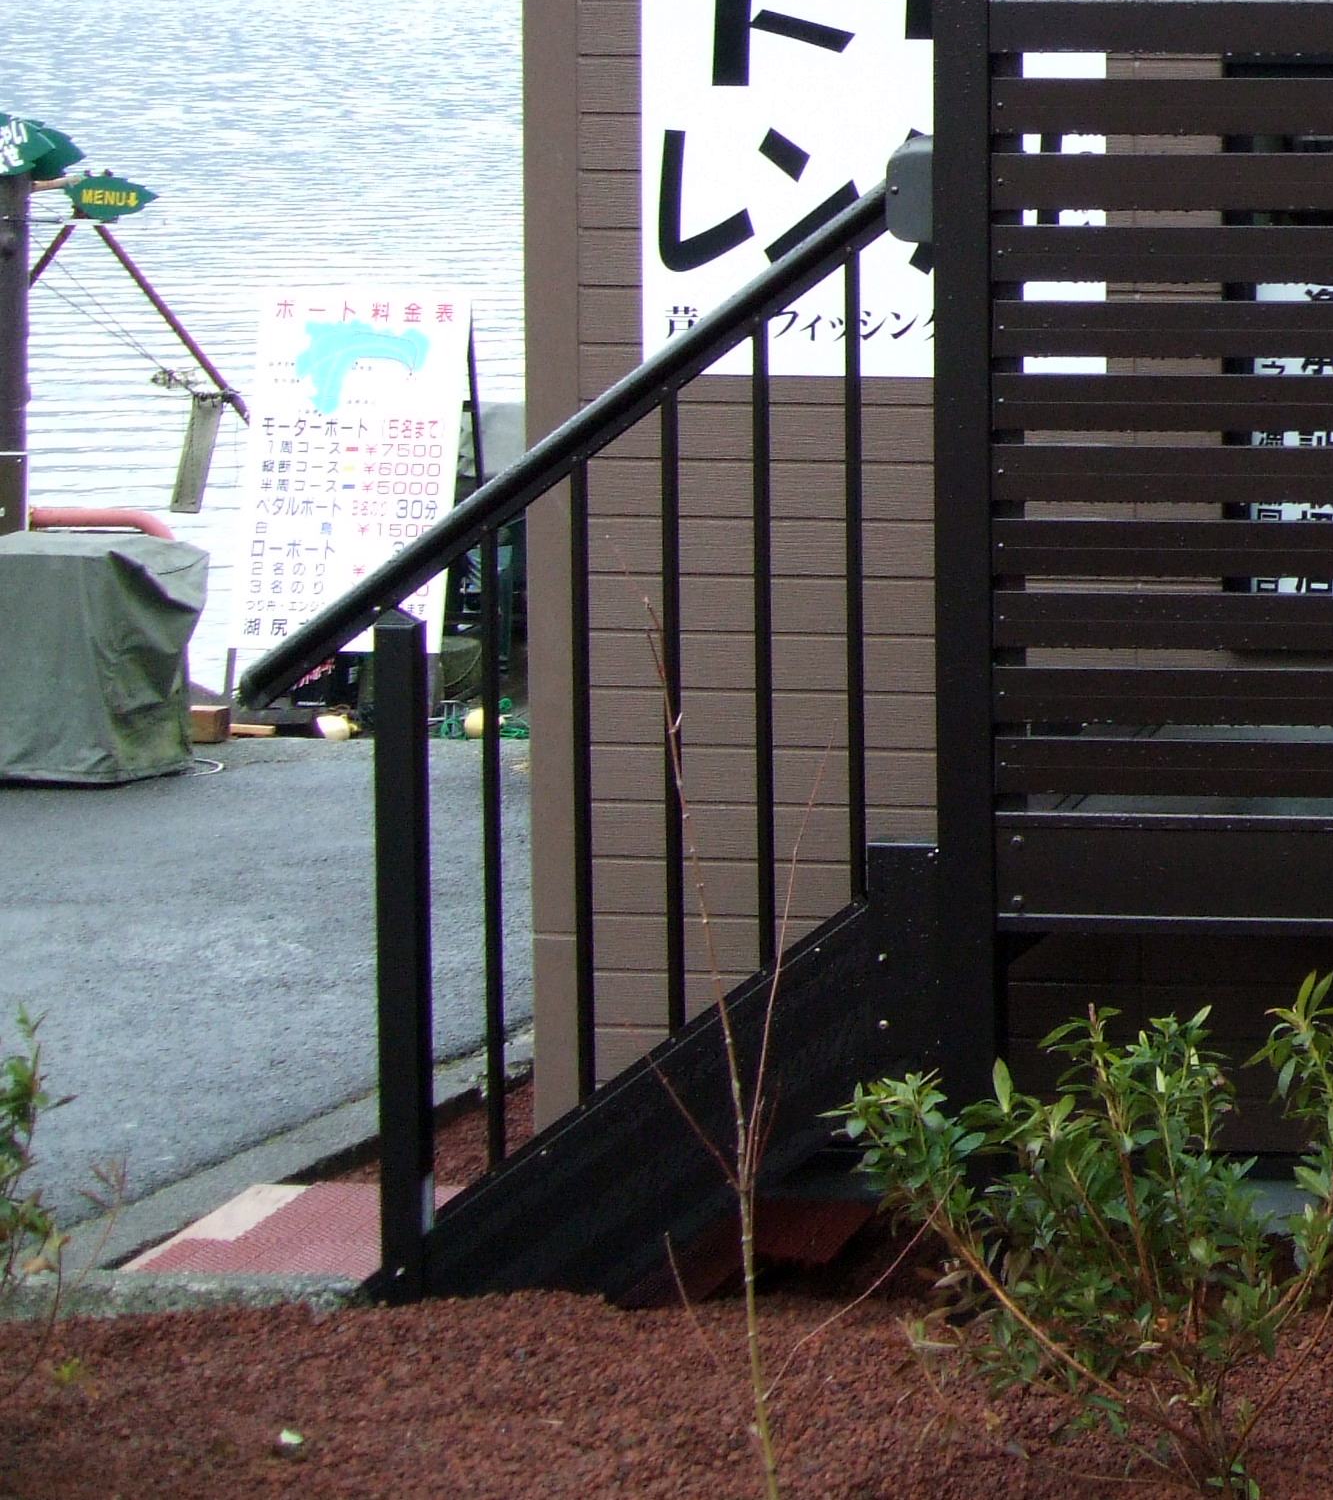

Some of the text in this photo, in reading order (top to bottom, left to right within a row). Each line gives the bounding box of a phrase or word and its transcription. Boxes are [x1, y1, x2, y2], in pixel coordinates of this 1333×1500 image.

[82, 189, 126, 206] MENU
[665, 306, 934, 342] 芦フィッシン
[365, 443, 443, 458] ¥7500
[361, 480, 439, 496] ¥5000
